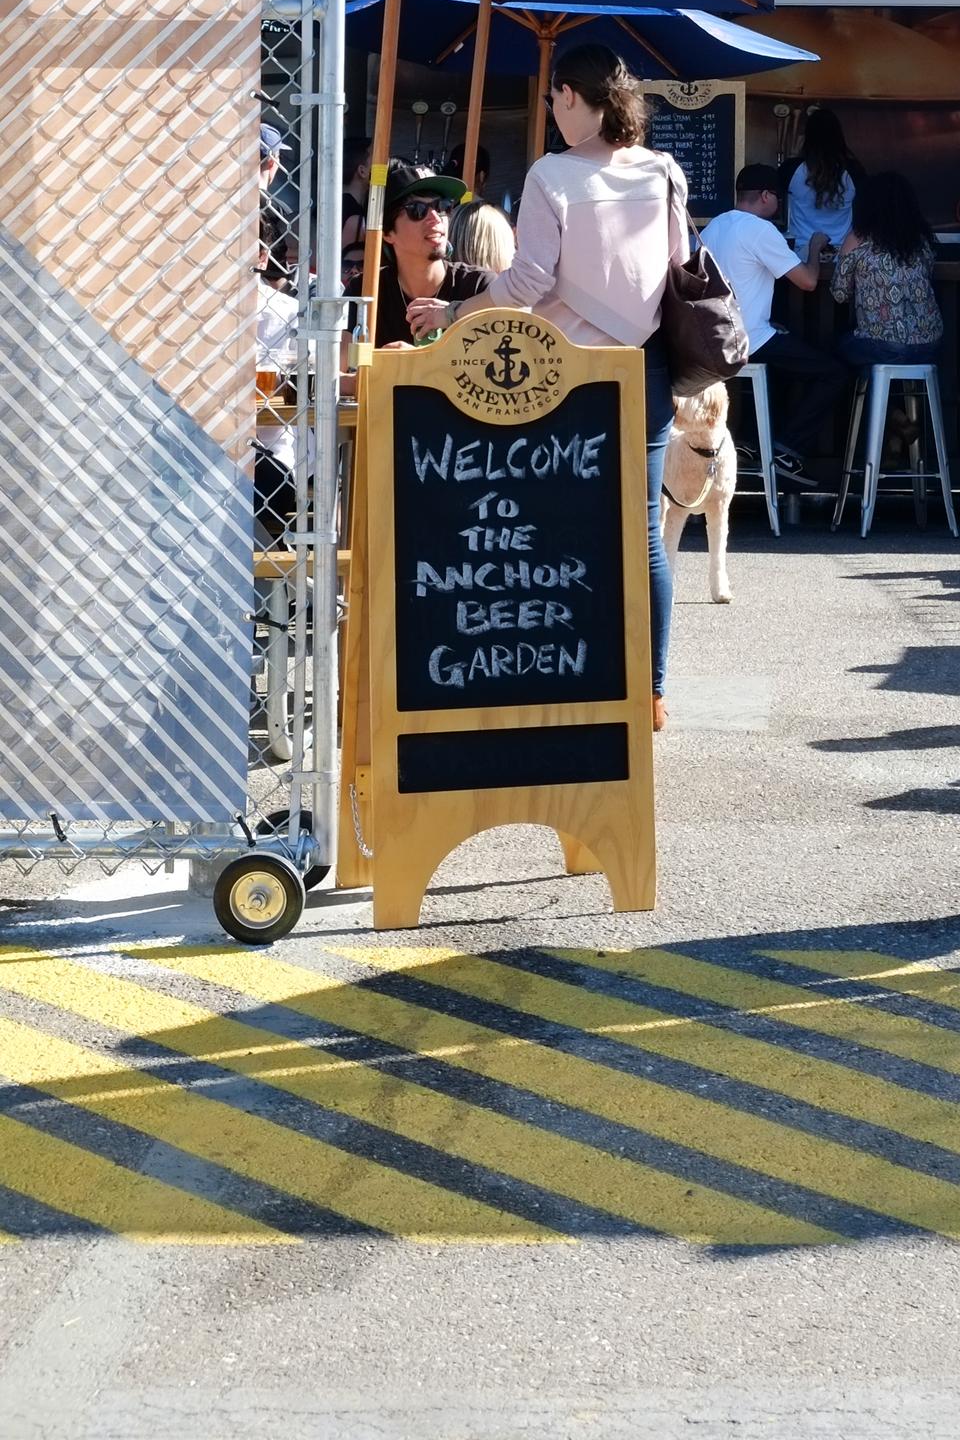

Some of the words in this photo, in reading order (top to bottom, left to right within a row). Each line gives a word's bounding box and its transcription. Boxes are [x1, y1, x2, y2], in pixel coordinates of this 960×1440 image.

[462, 320, 556, 354] ANCHOR
[451, 358, 487, 366] SINCE
[455, 369, 560, 406] BREWING
[456, 391, 480, 410] SAN
[486, 389, 560, 416] FRANCISCO
[411, 433, 606, 484] WELCOME
[469, 490, 520, 520] TO
[458, 524, 538, 552] THE
[411, 555, 593, 597] ANCHOR
[456, 599, 575, 636] BEER
[428, 638, 588, 689] GARDEN
